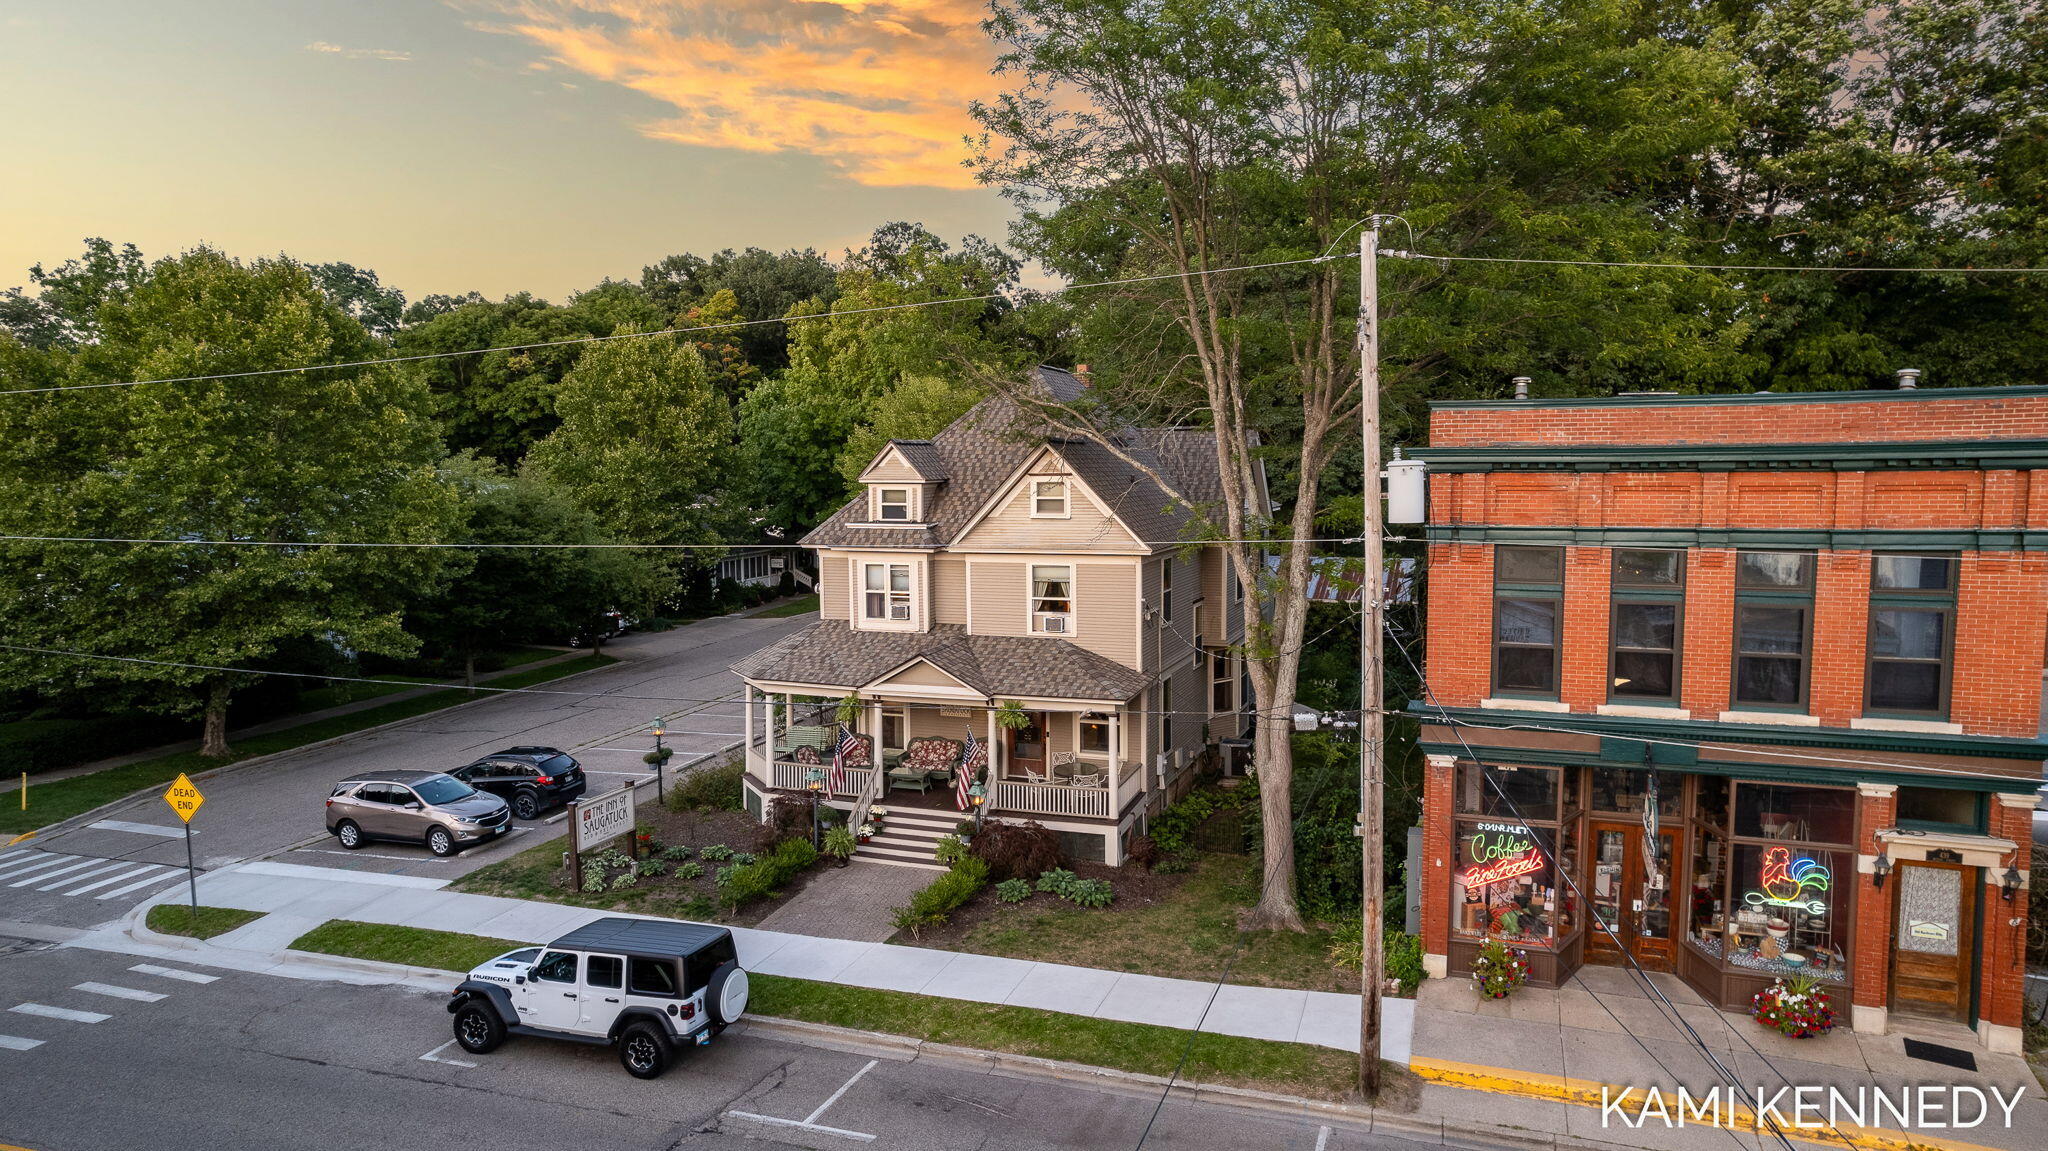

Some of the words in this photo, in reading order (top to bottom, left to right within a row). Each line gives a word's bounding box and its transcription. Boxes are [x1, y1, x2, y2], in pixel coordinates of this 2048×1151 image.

[173, 788, 195, 798] DEAD
[178, 801, 193, 810] END
[592, 804, 603, 817] THE
[606, 799, 618, 812] INN
[584, 807, 627, 834] SAUGATUCK
[1477, 823, 1527, 834] GOURMET
[1471, 834, 1534, 864] Coffee
[1466, 867, 1497, 888] Fine
[1495, 848, 1543, 880] Foods
[473, 974, 510, 982] RUBICON
